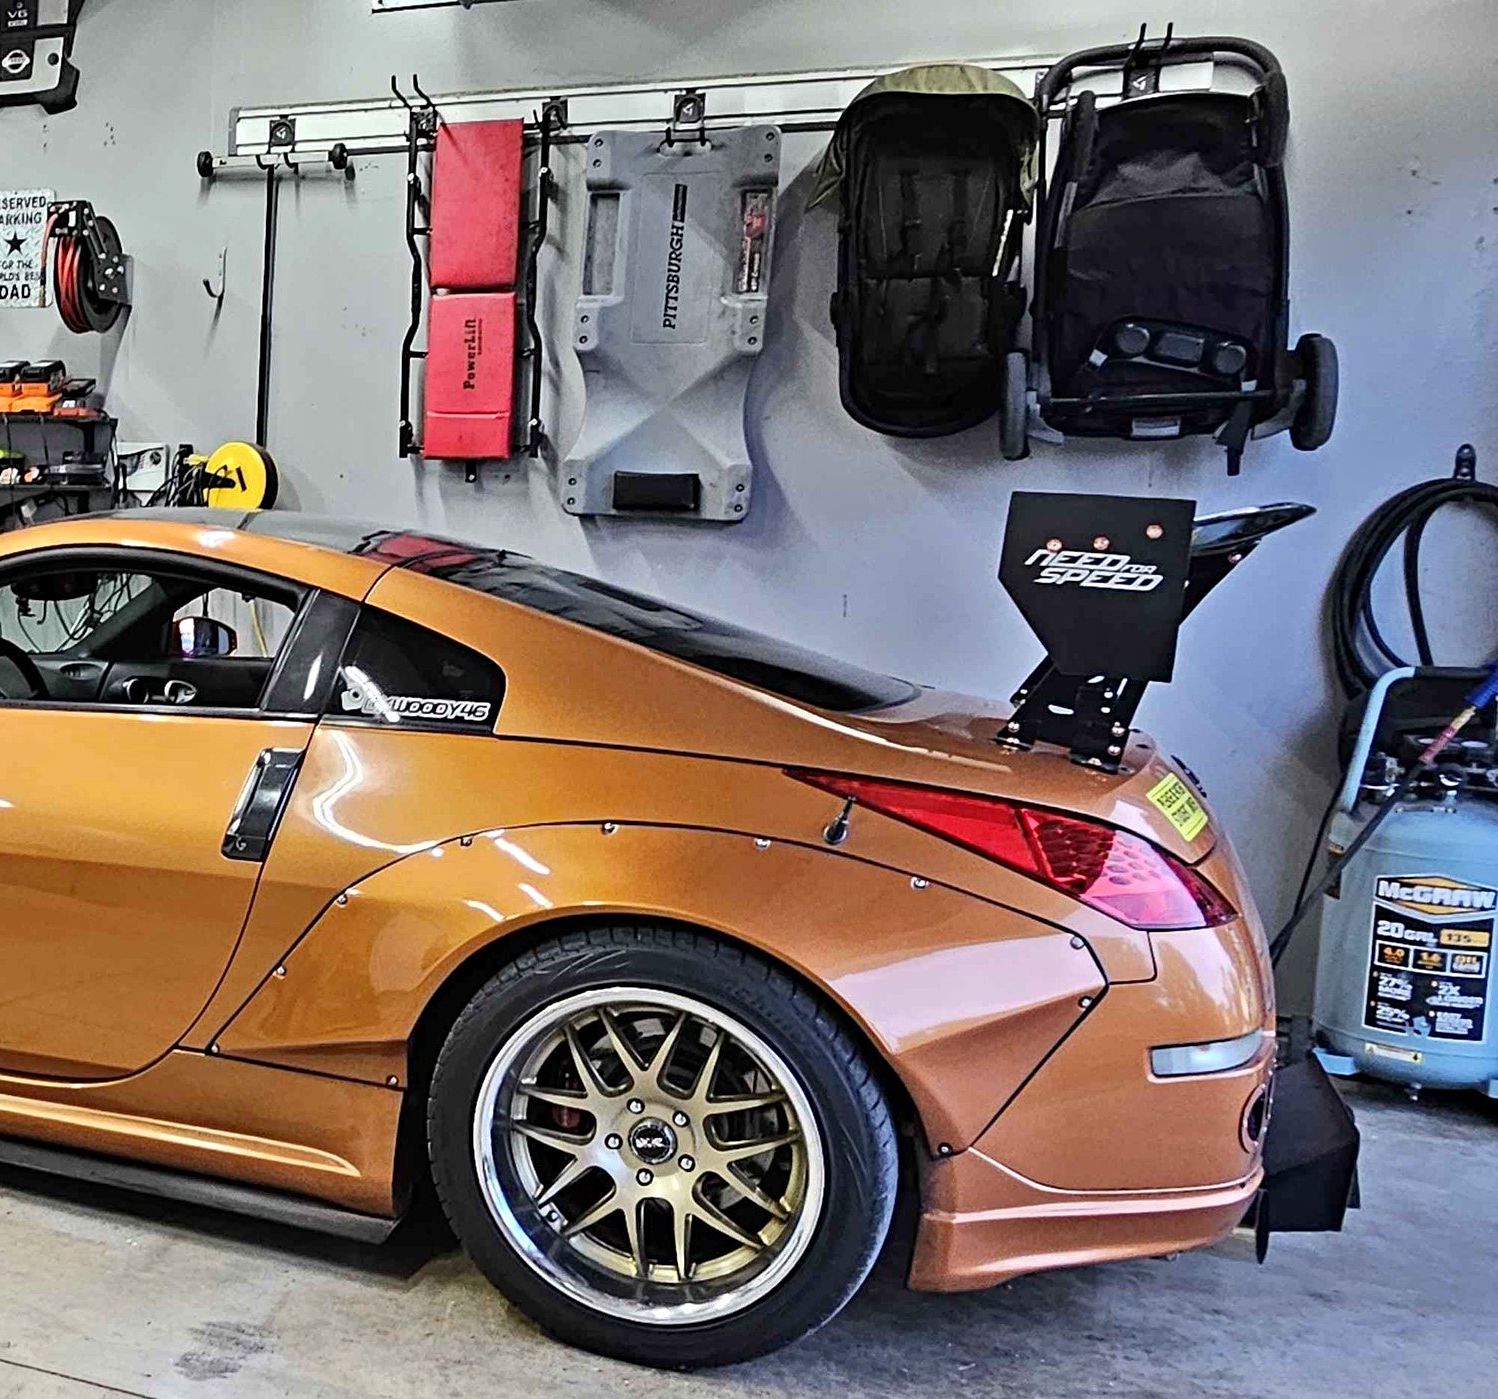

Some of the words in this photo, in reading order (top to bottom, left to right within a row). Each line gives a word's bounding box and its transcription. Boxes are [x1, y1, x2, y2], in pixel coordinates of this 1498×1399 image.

[7, 9, 28, 18] V6
[17, 259, 32, 269] THE
[25, 271, 43, 281] BES
[663, 225, 684, 329] PITTSBURGH
[1024, 549, 1131, 572] NEED
[1120, 565, 1158, 575] FOR
[1033, 568, 1164, 591] SPEED
[1378, 880, 1496, 908] McGRAW
[1377, 920, 1405, 938] 20
